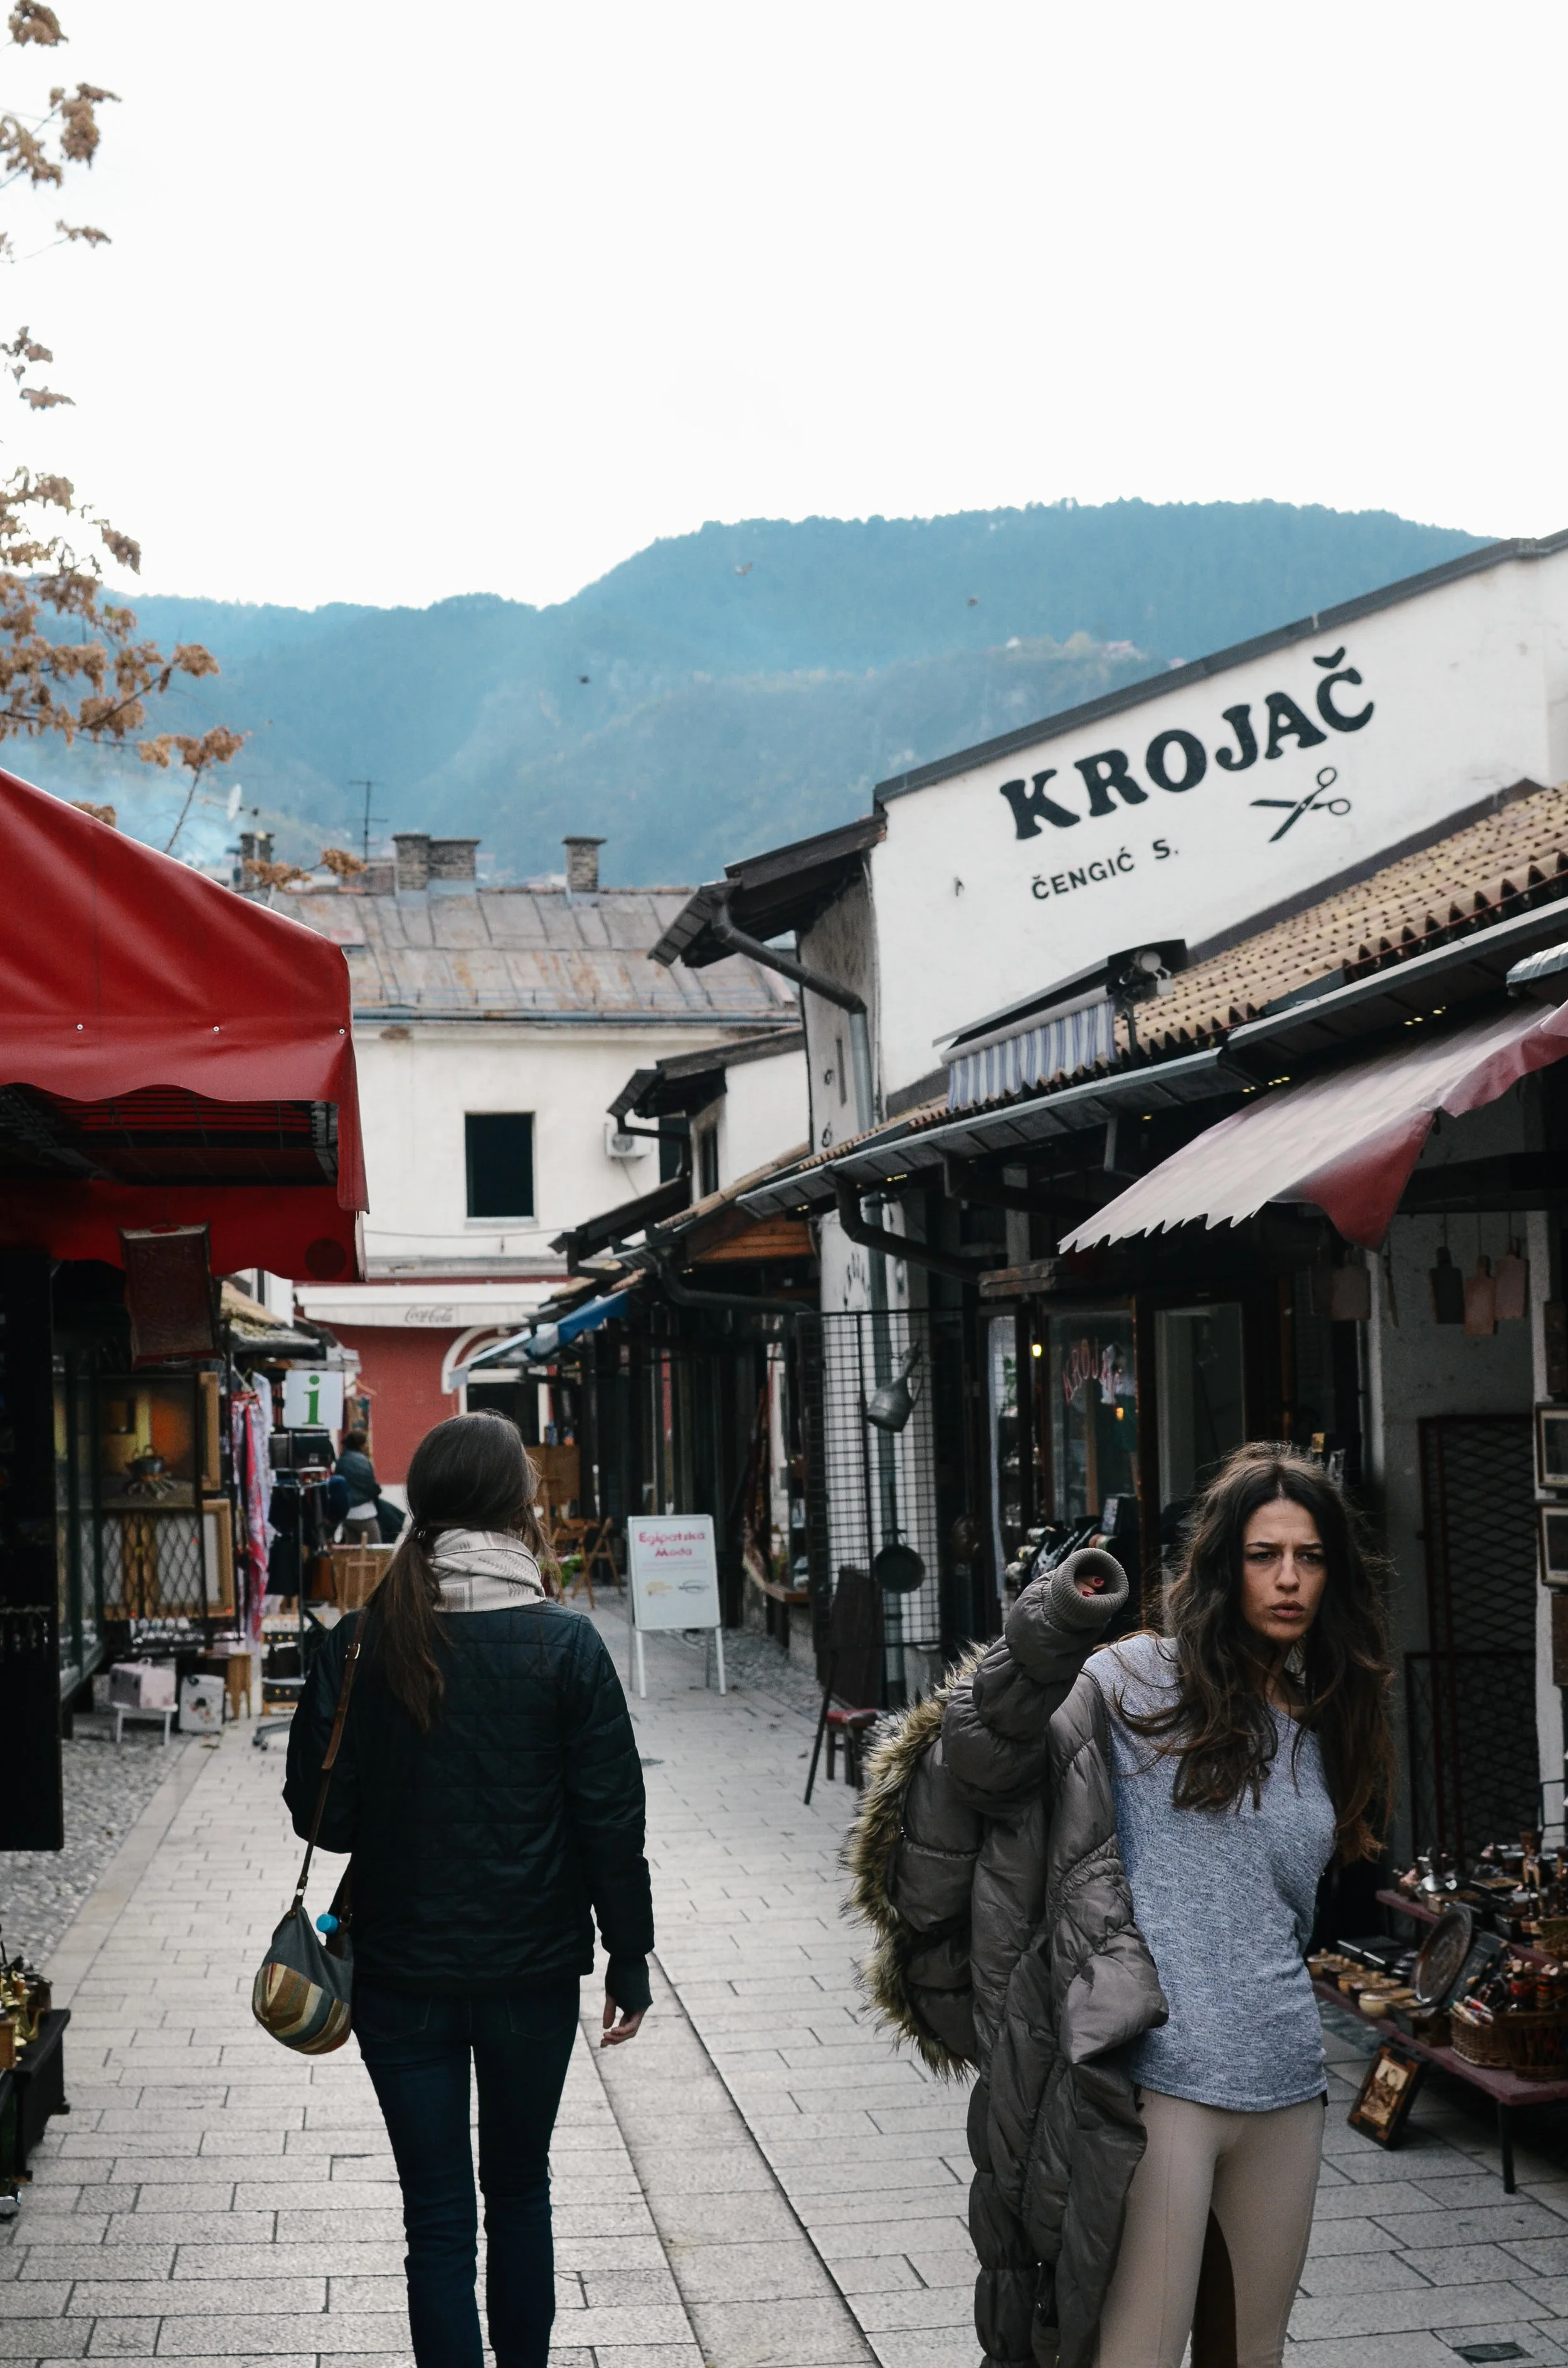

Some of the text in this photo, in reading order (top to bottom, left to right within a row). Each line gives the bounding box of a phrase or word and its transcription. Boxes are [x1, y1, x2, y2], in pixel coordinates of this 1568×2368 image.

[1000, 647, 1375, 840] KROJAČ
[1032, 839, 1179, 900] ČENGIĆ S.
